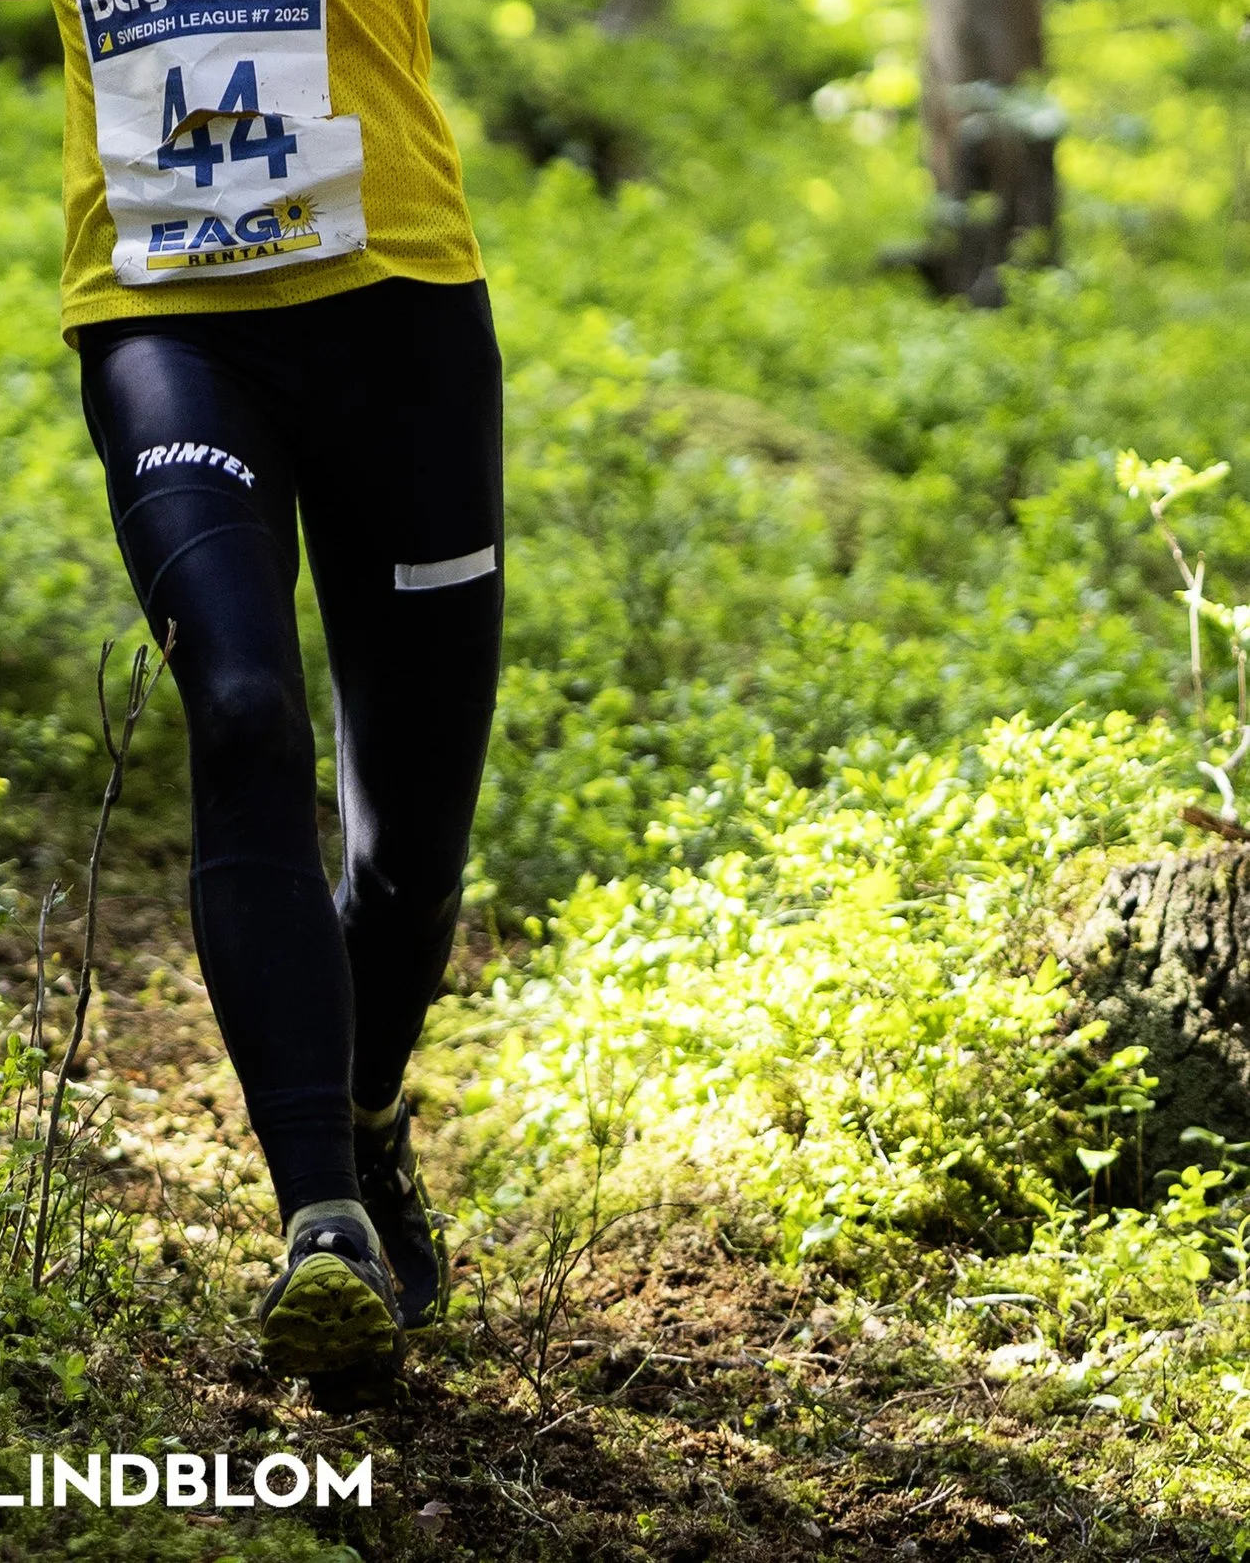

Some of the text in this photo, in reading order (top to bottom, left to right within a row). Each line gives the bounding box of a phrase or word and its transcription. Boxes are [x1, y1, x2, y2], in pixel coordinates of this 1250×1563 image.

[116, 7, 310, 46] SWEDISH LEAGUE #7 2025
[156, 60, 298, 189] 44
[147, 207, 283, 253] EAG
[187, 241, 284, 266] RENTAL
[135, 442, 256, 489] TRIMTEX
